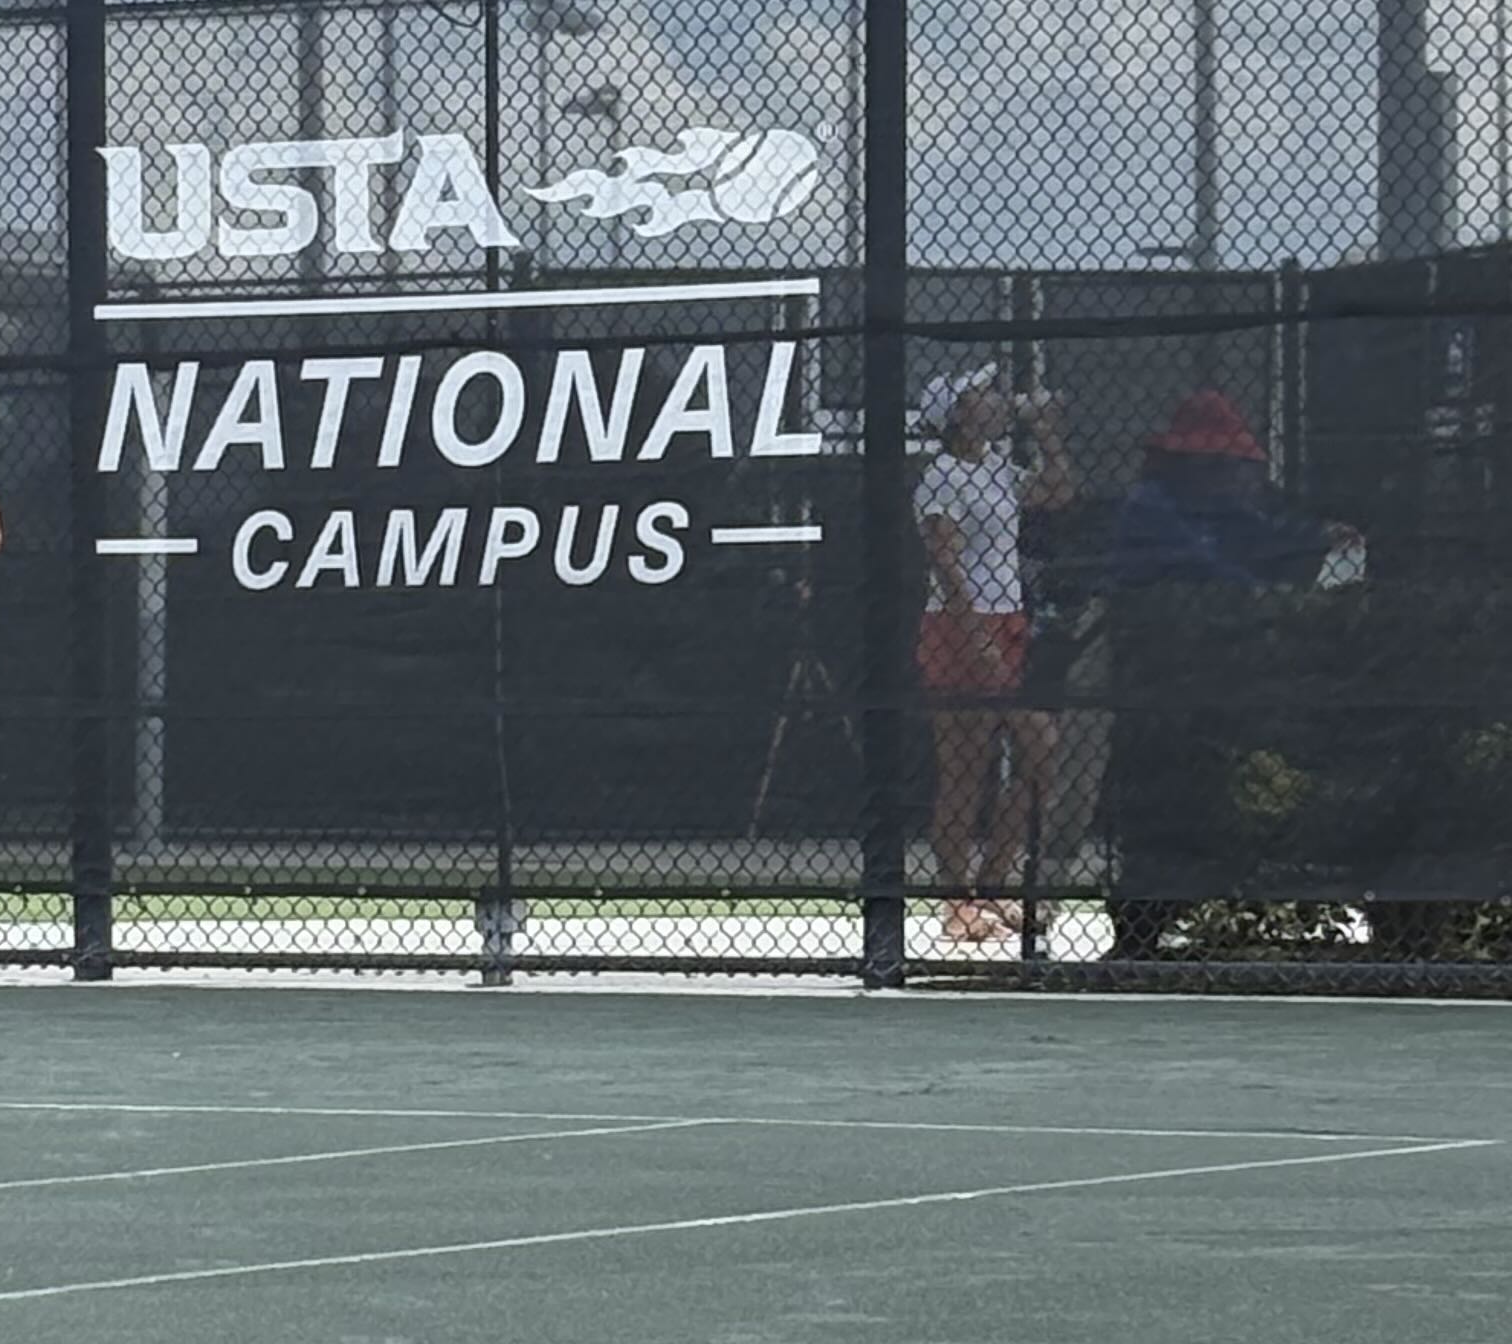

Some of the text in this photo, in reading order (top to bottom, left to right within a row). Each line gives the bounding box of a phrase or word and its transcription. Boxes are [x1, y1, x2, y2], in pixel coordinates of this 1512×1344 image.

[96, 130, 520, 258] USTA
[97, 342, 822, 472] NATIONAL
[231, 502, 689, 590] CAMPUS
